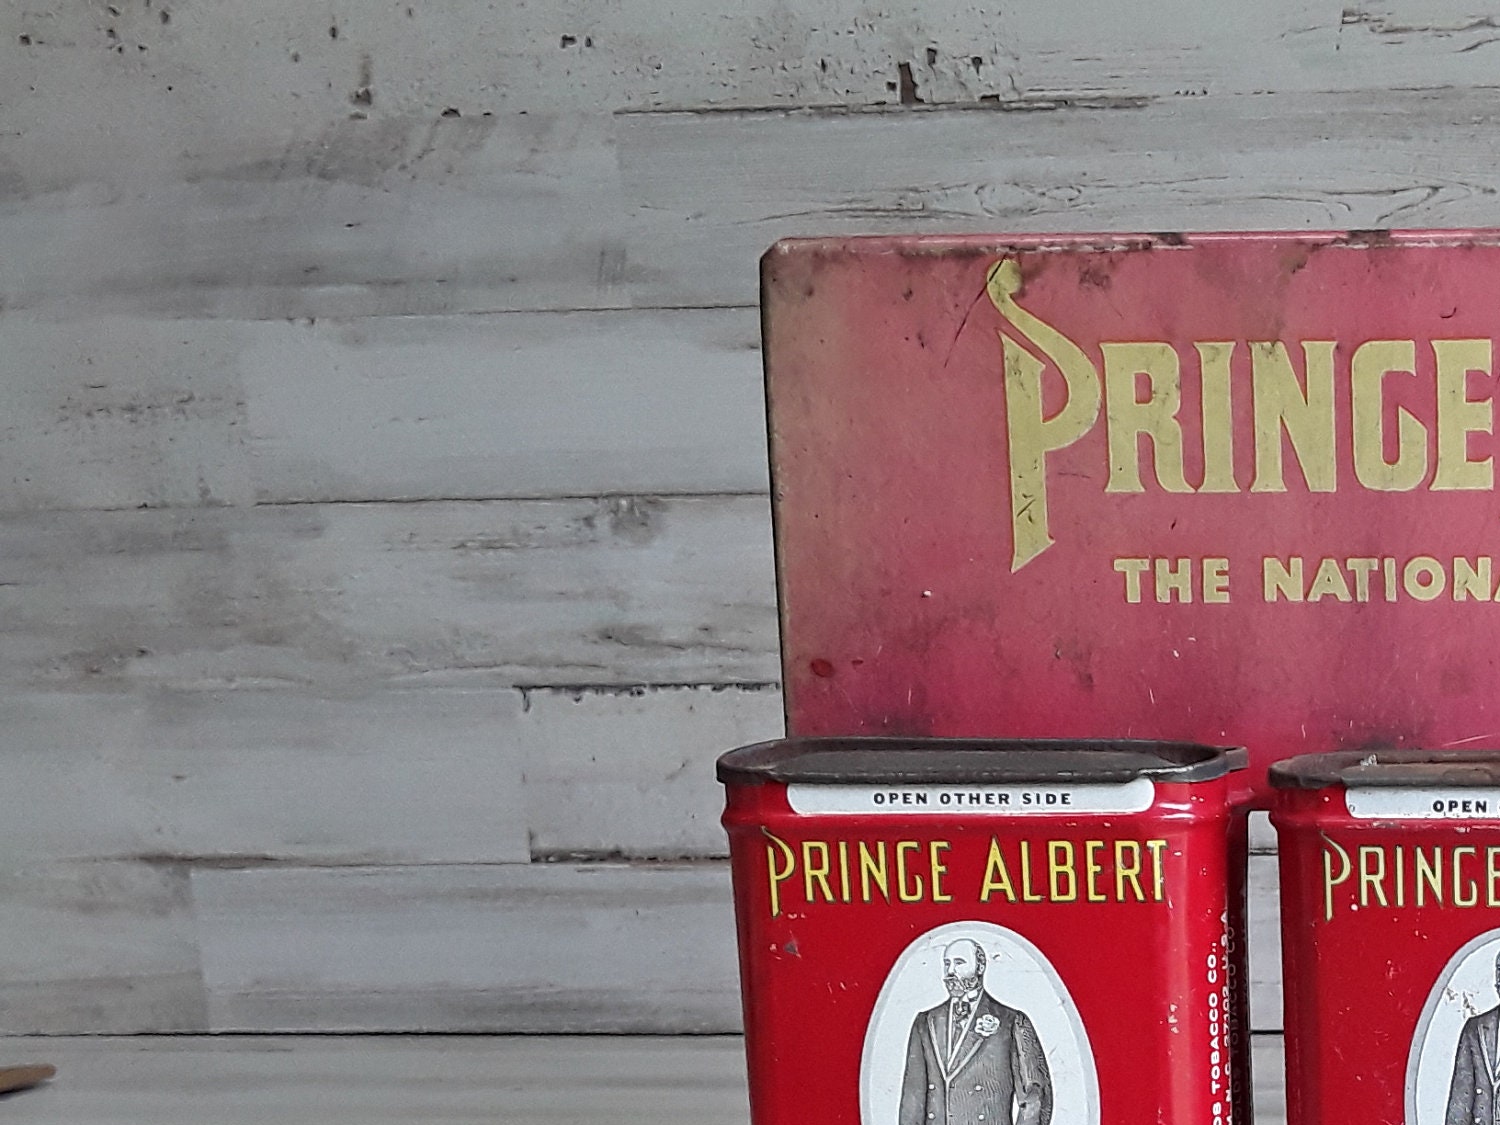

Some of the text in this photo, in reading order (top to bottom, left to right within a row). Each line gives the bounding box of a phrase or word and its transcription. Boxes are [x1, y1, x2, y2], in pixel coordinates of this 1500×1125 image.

[987, 257, 1495, 574] PRINCE
[1113, 557, 1230, 605] THE
[873, 792, 1071, 805] OPEN OTHER SIDE
[1433, 801, 1487, 813] OPEN
[761, 825, 1168, 918] PRINCE ALBERT
[1208, 993, 1221, 1095] TOBACCO
